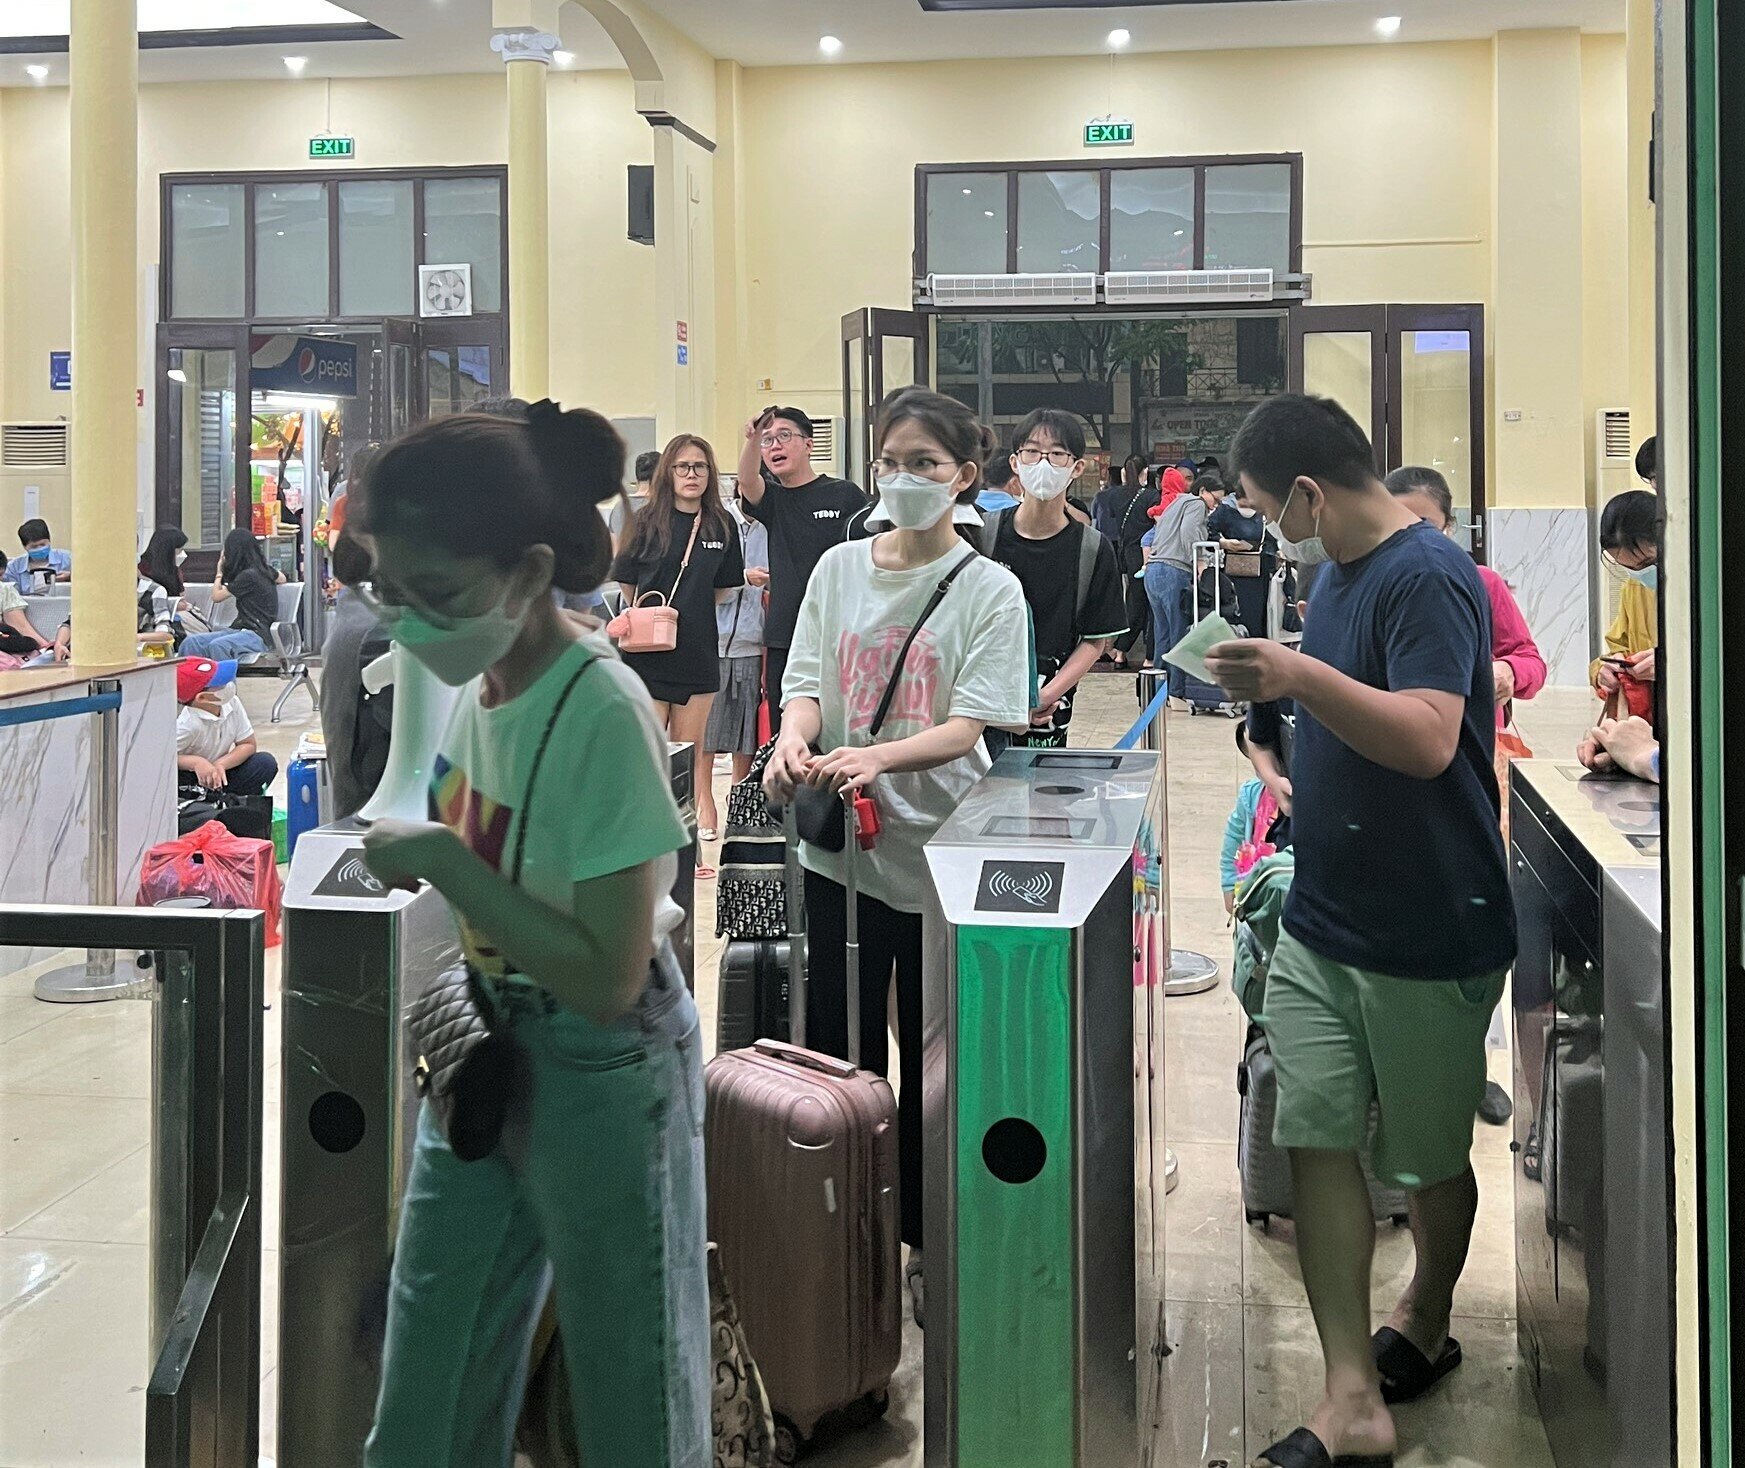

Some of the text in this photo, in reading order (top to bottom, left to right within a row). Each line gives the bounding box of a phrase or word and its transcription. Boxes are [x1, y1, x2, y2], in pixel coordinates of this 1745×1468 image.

[1088, 125, 1131, 141] EXIT
[311, 139, 351, 154] EXIT
[318, 357, 352, 382] pepsi
[812, 509, 841, 520] TEDDY
